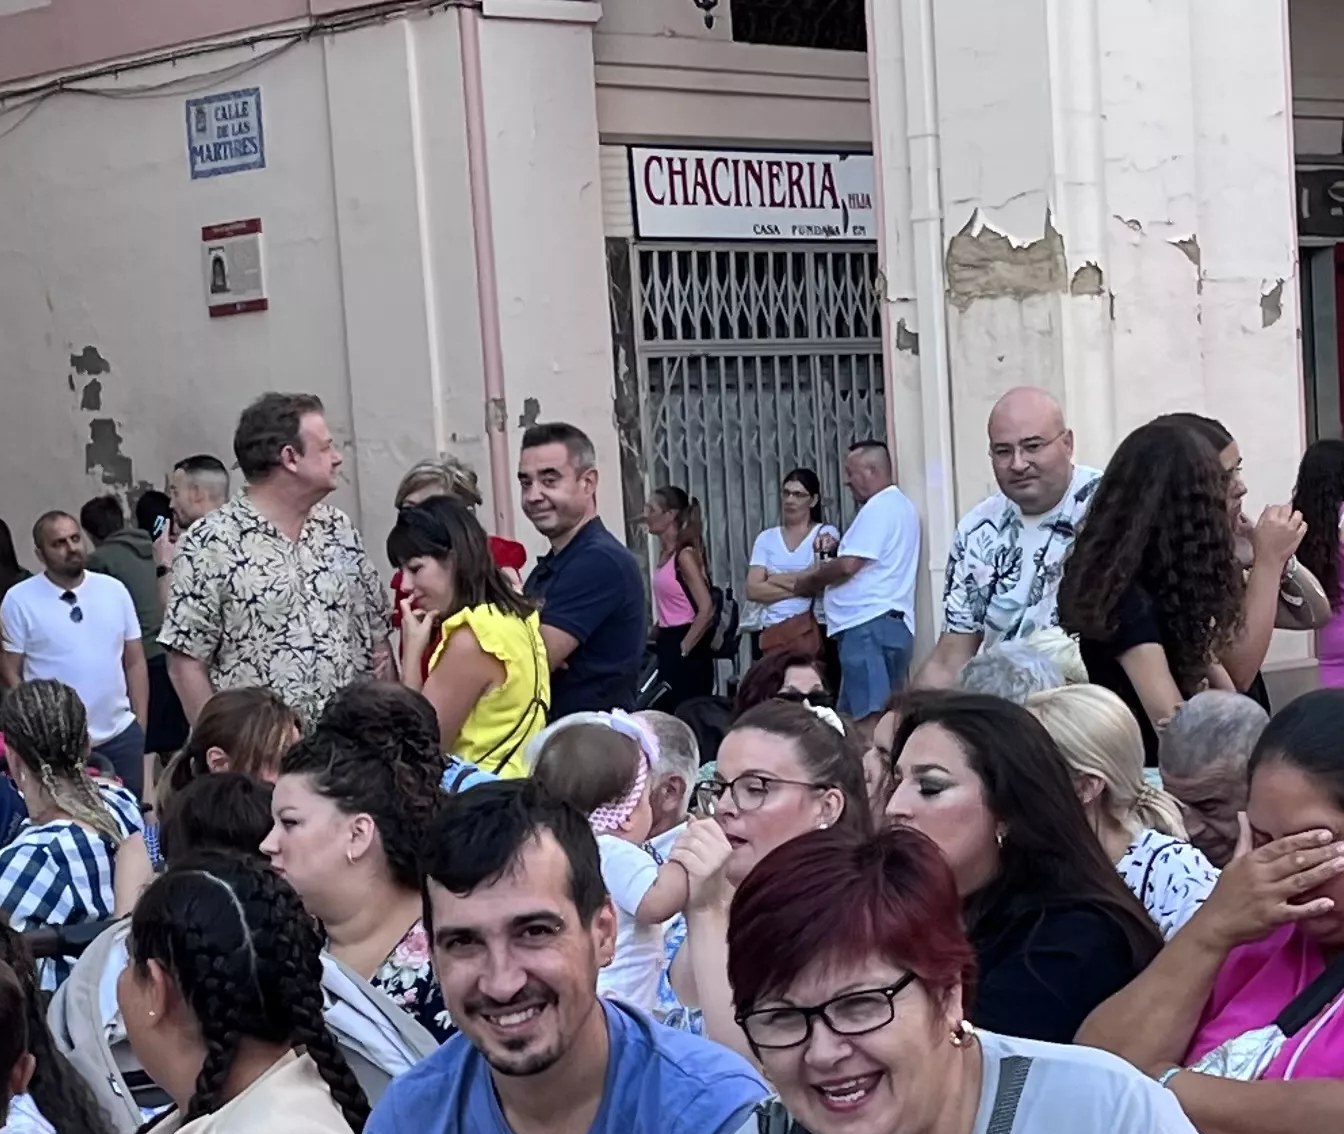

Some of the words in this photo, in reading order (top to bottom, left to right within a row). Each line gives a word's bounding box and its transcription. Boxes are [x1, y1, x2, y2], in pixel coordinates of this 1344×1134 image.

[215, 101, 249, 122] CALLE
[217, 124, 229, 139] DE
[231, 120, 250, 136] LAS
[644, 155, 840, 210] CHACINERIA
[753, 223, 781, 236] CASA
